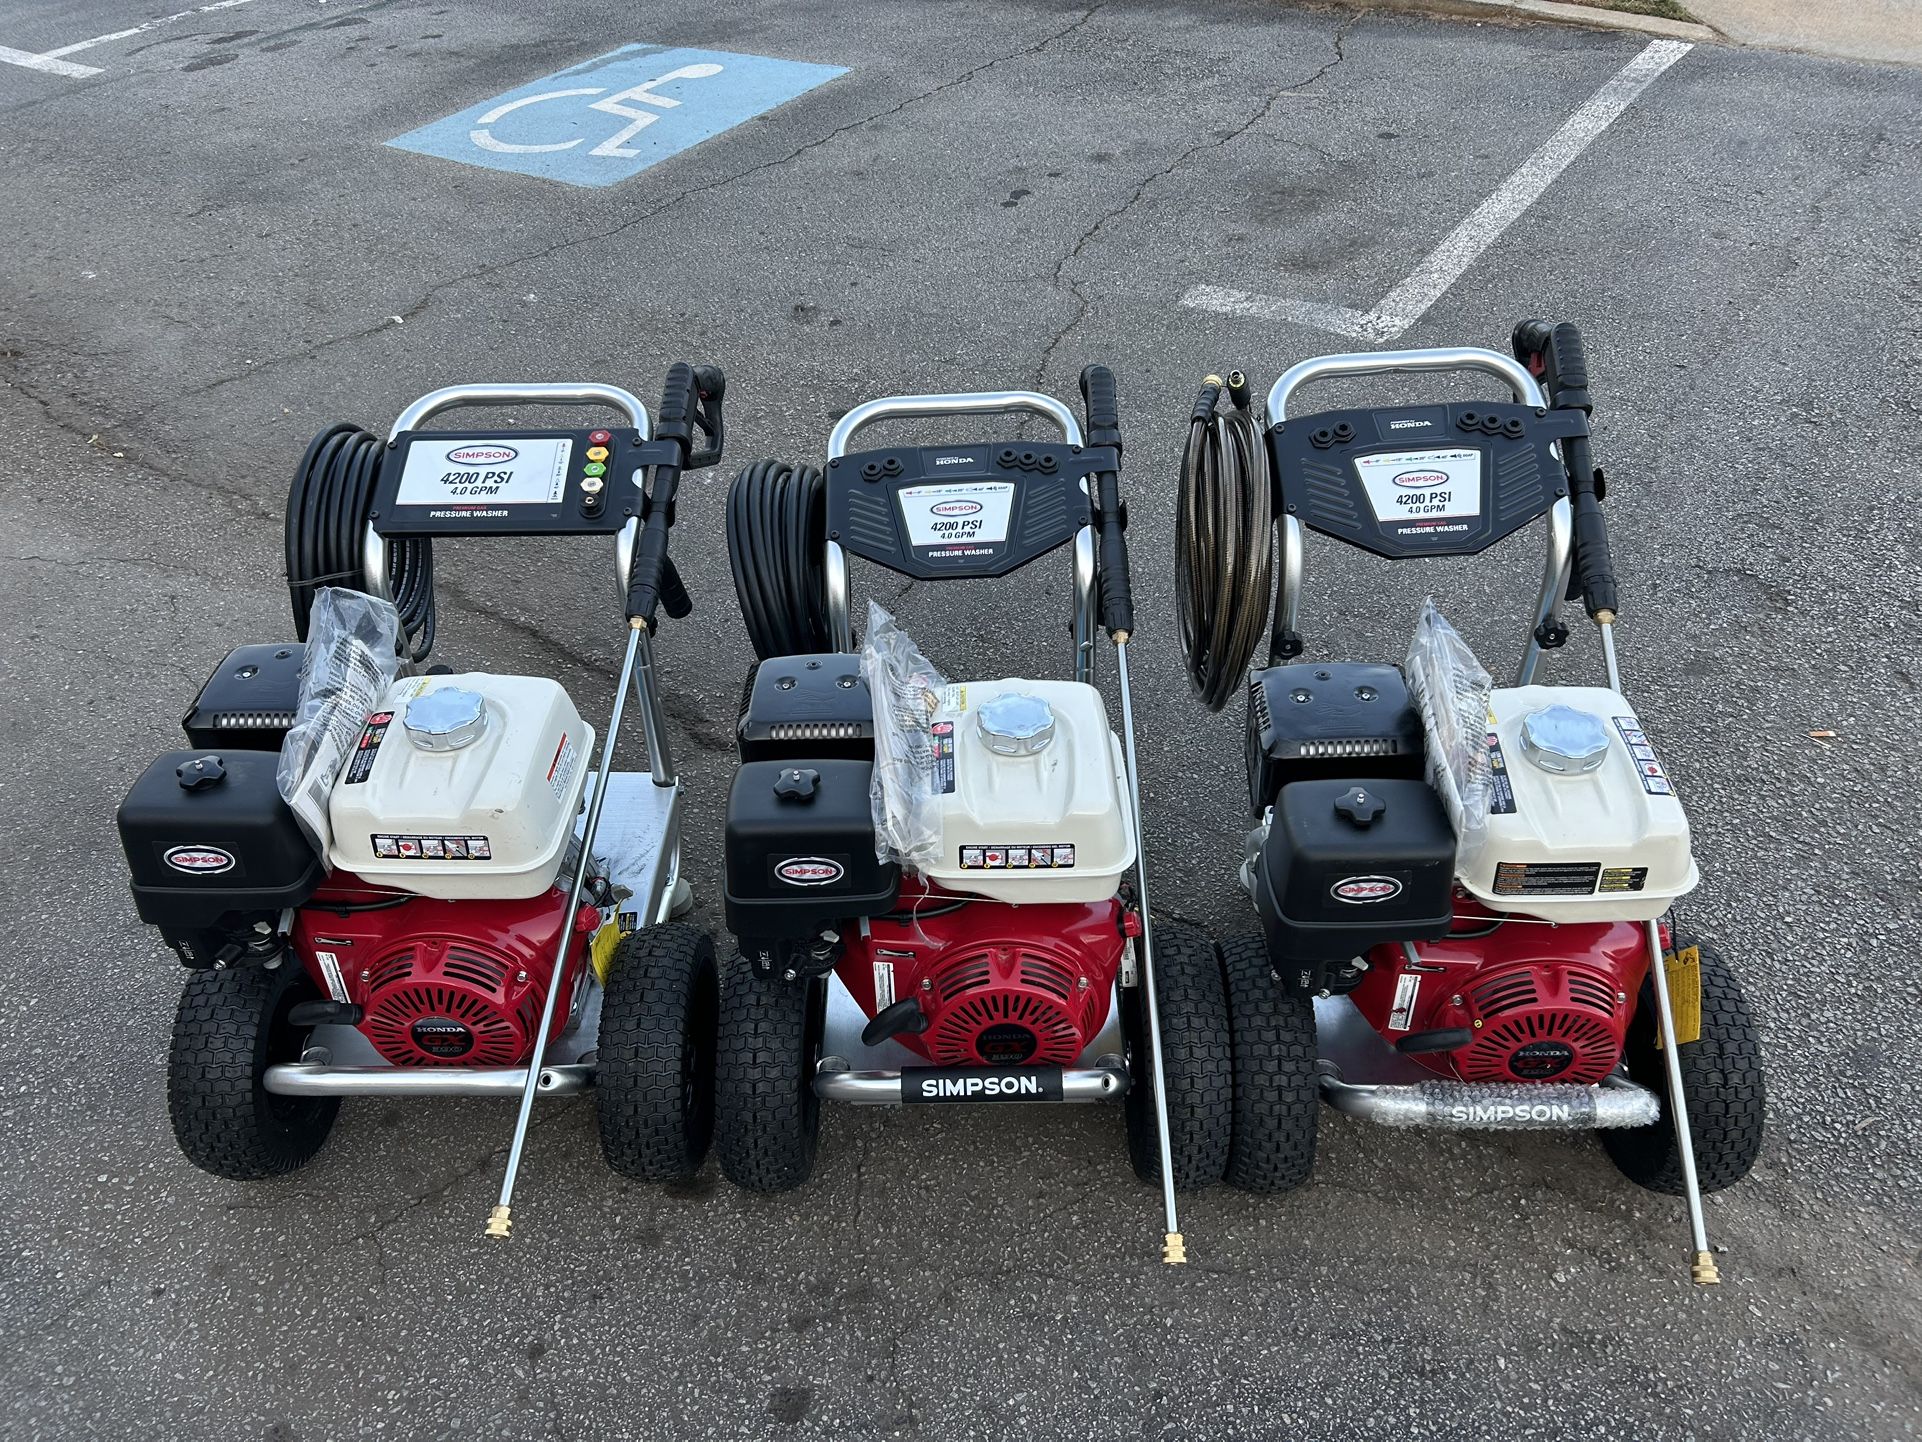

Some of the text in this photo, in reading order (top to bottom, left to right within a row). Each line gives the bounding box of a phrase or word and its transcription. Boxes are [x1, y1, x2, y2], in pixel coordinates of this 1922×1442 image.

[1390, 421, 1432, 430] HONDA
[454, 451, 511, 459] SIMPSON
[936, 457, 974, 466] HONDA
[440, 471, 513, 485] 4200 PSI
[1398, 475, 1444, 484] SIMPSON
[450, 485, 499, 496] 4.0 GPM
[1396, 492, 1452, 505] 4200 PSI
[430, 509, 509, 519] PRESSURE WASHER
[936, 505, 977, 513] SIMPSON
[1408, 505, 1446, 514] 4.0 GPM
[931, 520, 983, 532] 4200 PSI
[1397, 524, 1469, 535] PRESSURE WASHER
[940, 531, 976, 540] 4.0 GPM
[928, 548, 994, 558] PRESSURE WASHER
[174, 855, 224, 865] SIMPSON
[785, 867, 833, 877] SIMPSON
[1338, 885, 1393, 895] SIMPSON
[921, 1075, 1039, 1097] SIMPSON
[1451, 1103, 1570, 1123] SIMPSON
